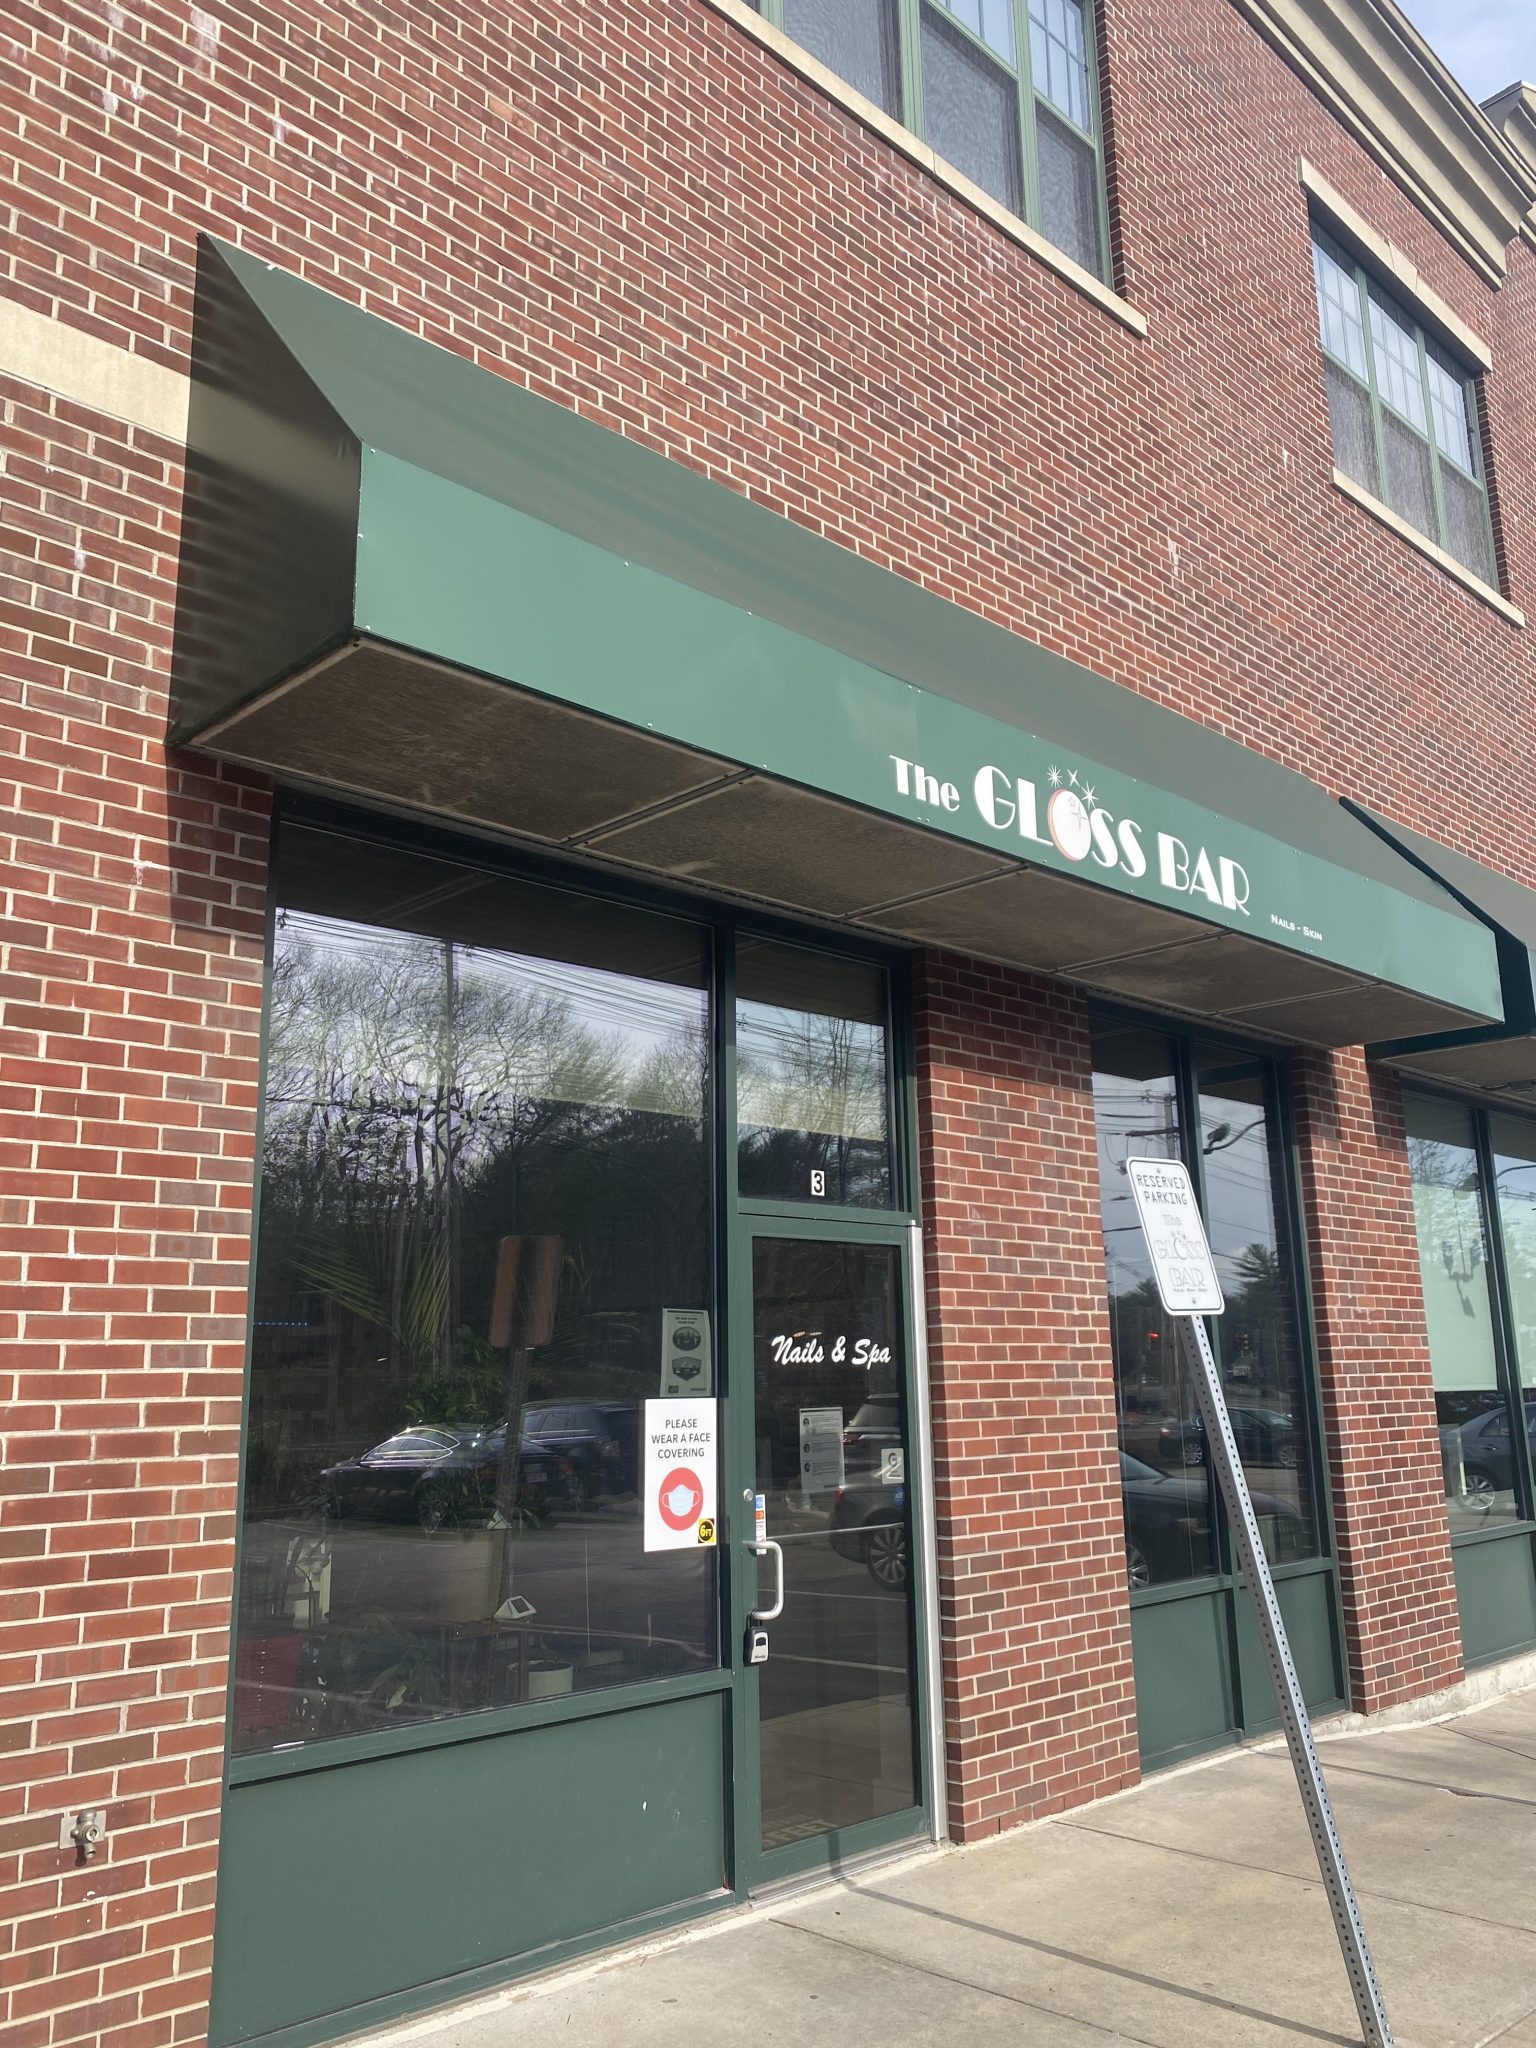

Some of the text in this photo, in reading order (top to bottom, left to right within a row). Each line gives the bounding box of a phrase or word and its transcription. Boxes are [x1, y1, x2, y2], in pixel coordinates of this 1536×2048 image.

[889, 755, 1250, 916] The GLOSS BAR
[813, 1172, 823, 1194] 3
[1136, 1174, 1186, 1190] RESERVED
[1144, 1190, 1188, 1206] PARKING
[1153, 1238, 1206, 1261] GLOSS
[1168, 1267, 1206, 1288] BAR
[771, 1335, 892, 1370] Nails & Spa
[665, 1418, 698, 1429] PLEASE
[651, 1432, 711, 1444] WEAR A FACE
[657, 1447, 705, 1459] COVERING
